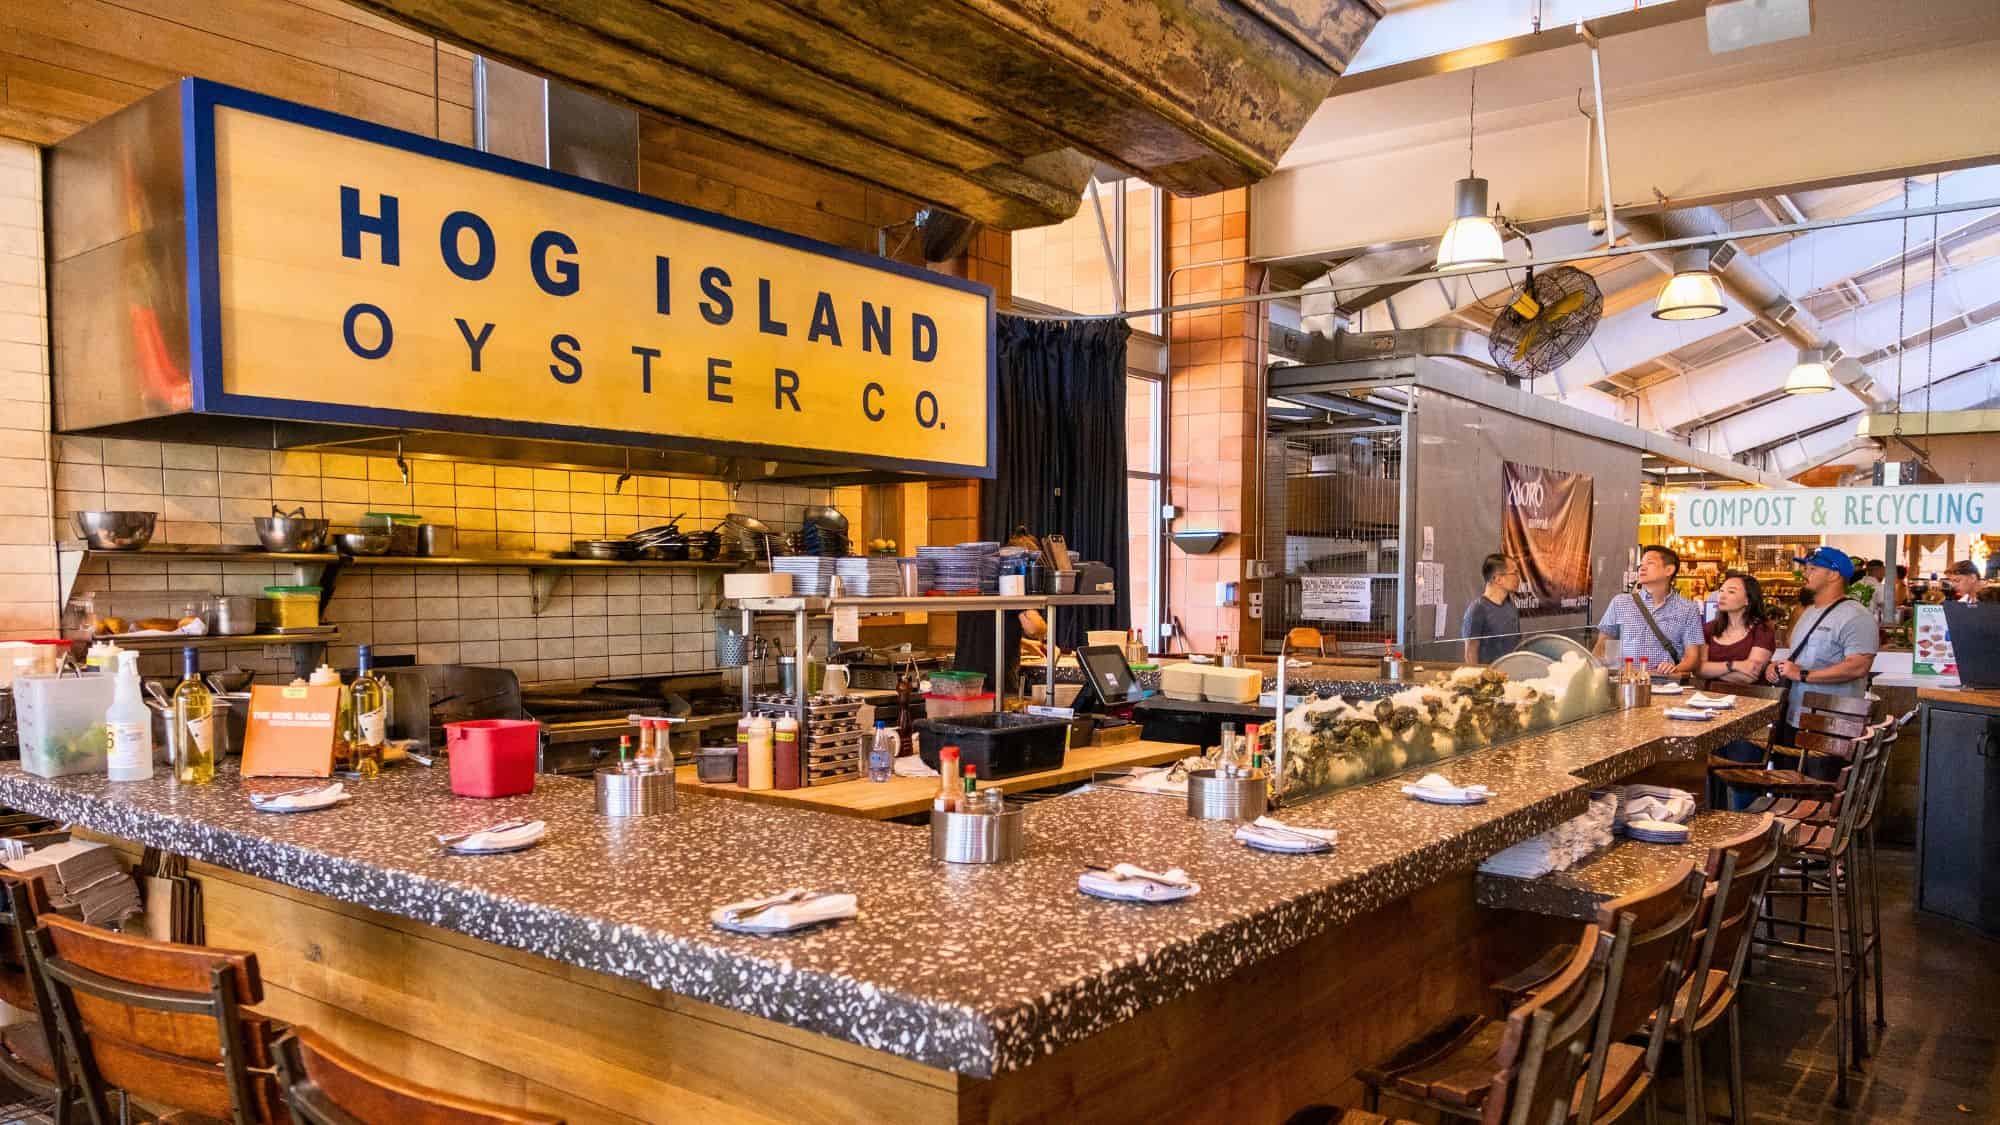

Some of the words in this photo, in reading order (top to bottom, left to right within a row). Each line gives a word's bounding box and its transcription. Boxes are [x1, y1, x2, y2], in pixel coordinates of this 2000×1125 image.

[340, 184, 580, 297] HOG
[655, 254, 939, 363] ISLAND
[342, 302, 802, 413] OYSTER
[862, 382, 946, 430] CO.
[1689, 495, 1797, 528] COMPOST
[1810, 494, 1828, 527] &
[1844, 492, 1985, 526] RECYCLING
